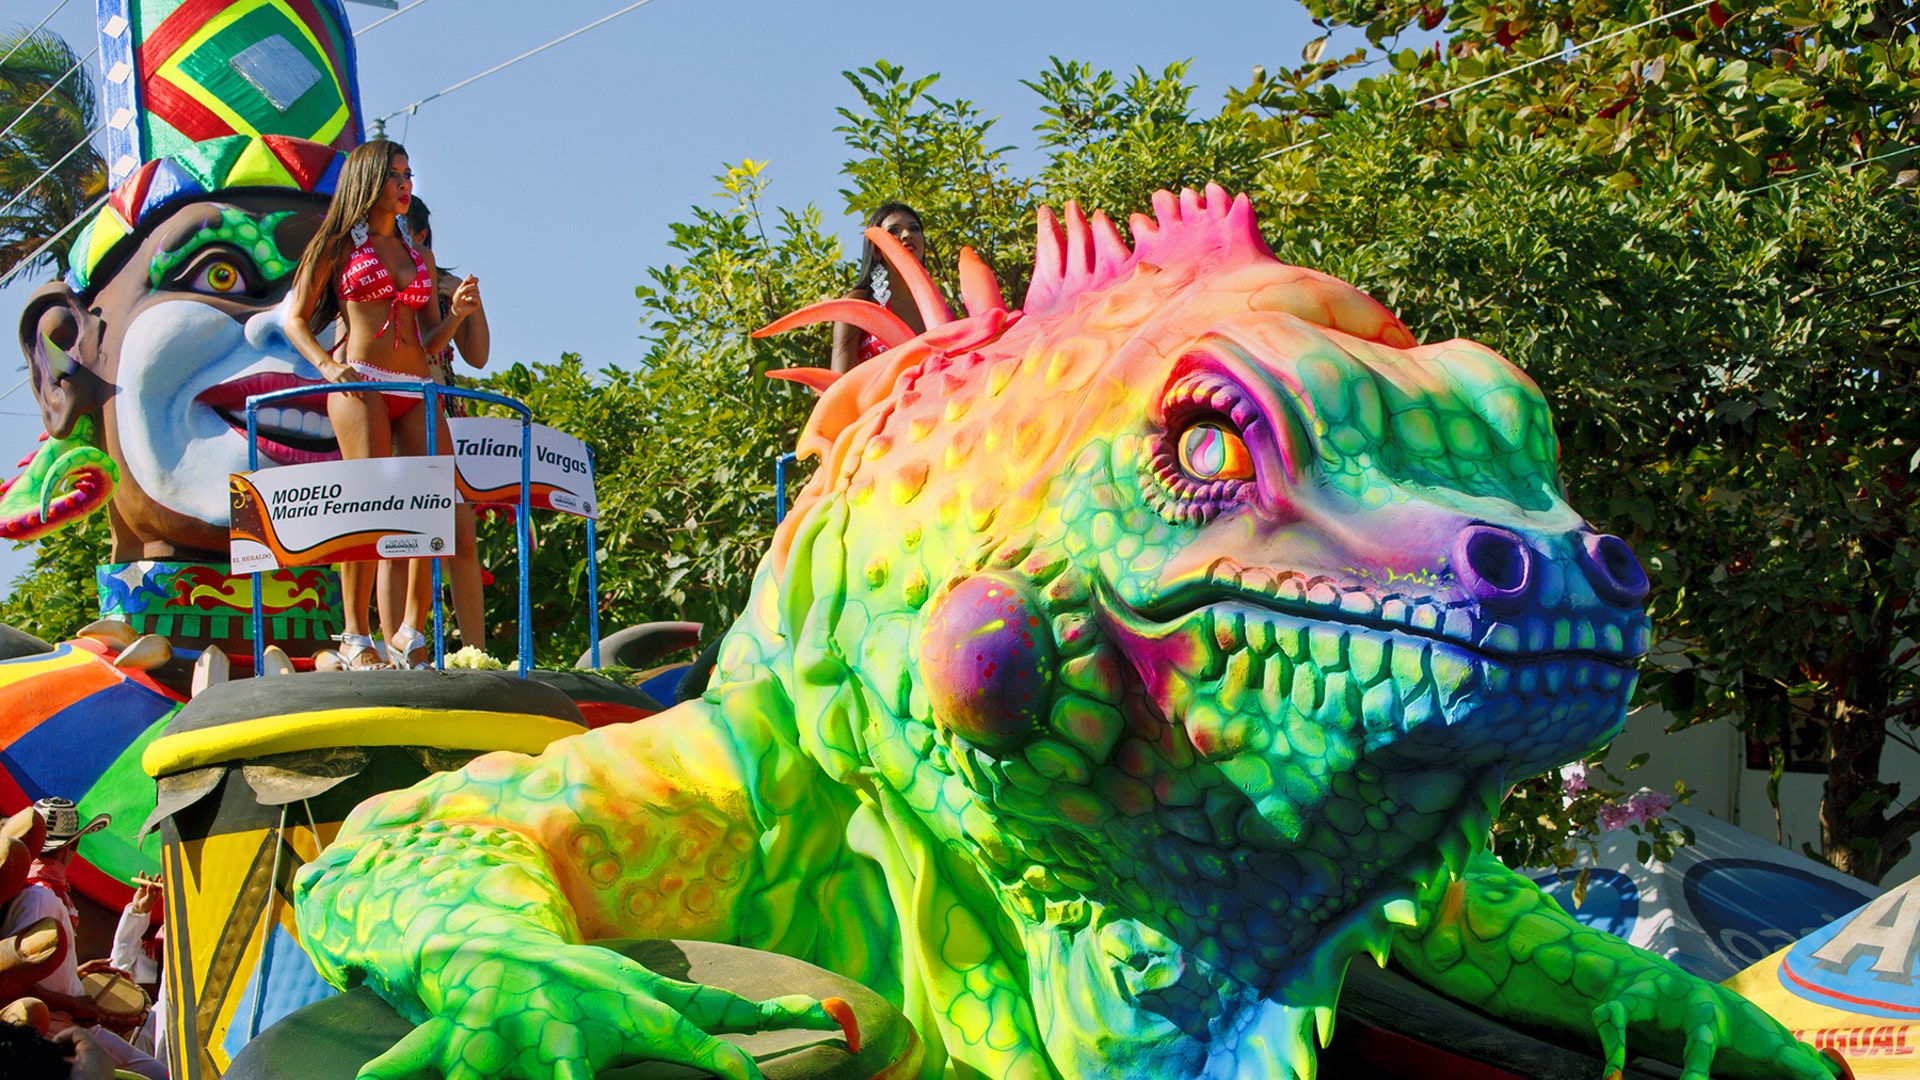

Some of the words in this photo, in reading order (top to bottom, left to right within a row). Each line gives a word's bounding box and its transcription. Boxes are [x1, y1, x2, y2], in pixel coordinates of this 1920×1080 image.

[359, 275, 376, 286] EL
[536, 445, 588, 475] Vargas
[272, 484, 342, 505] MODELO
[272, 501, 318, 521] María
[323, 495, 404, 515] Fernanda
[410, 493, 452, 510] Niño
[242, 553, 272, 562] HERALDO
[1815, 1025, 1915, 1056] IGUAL
